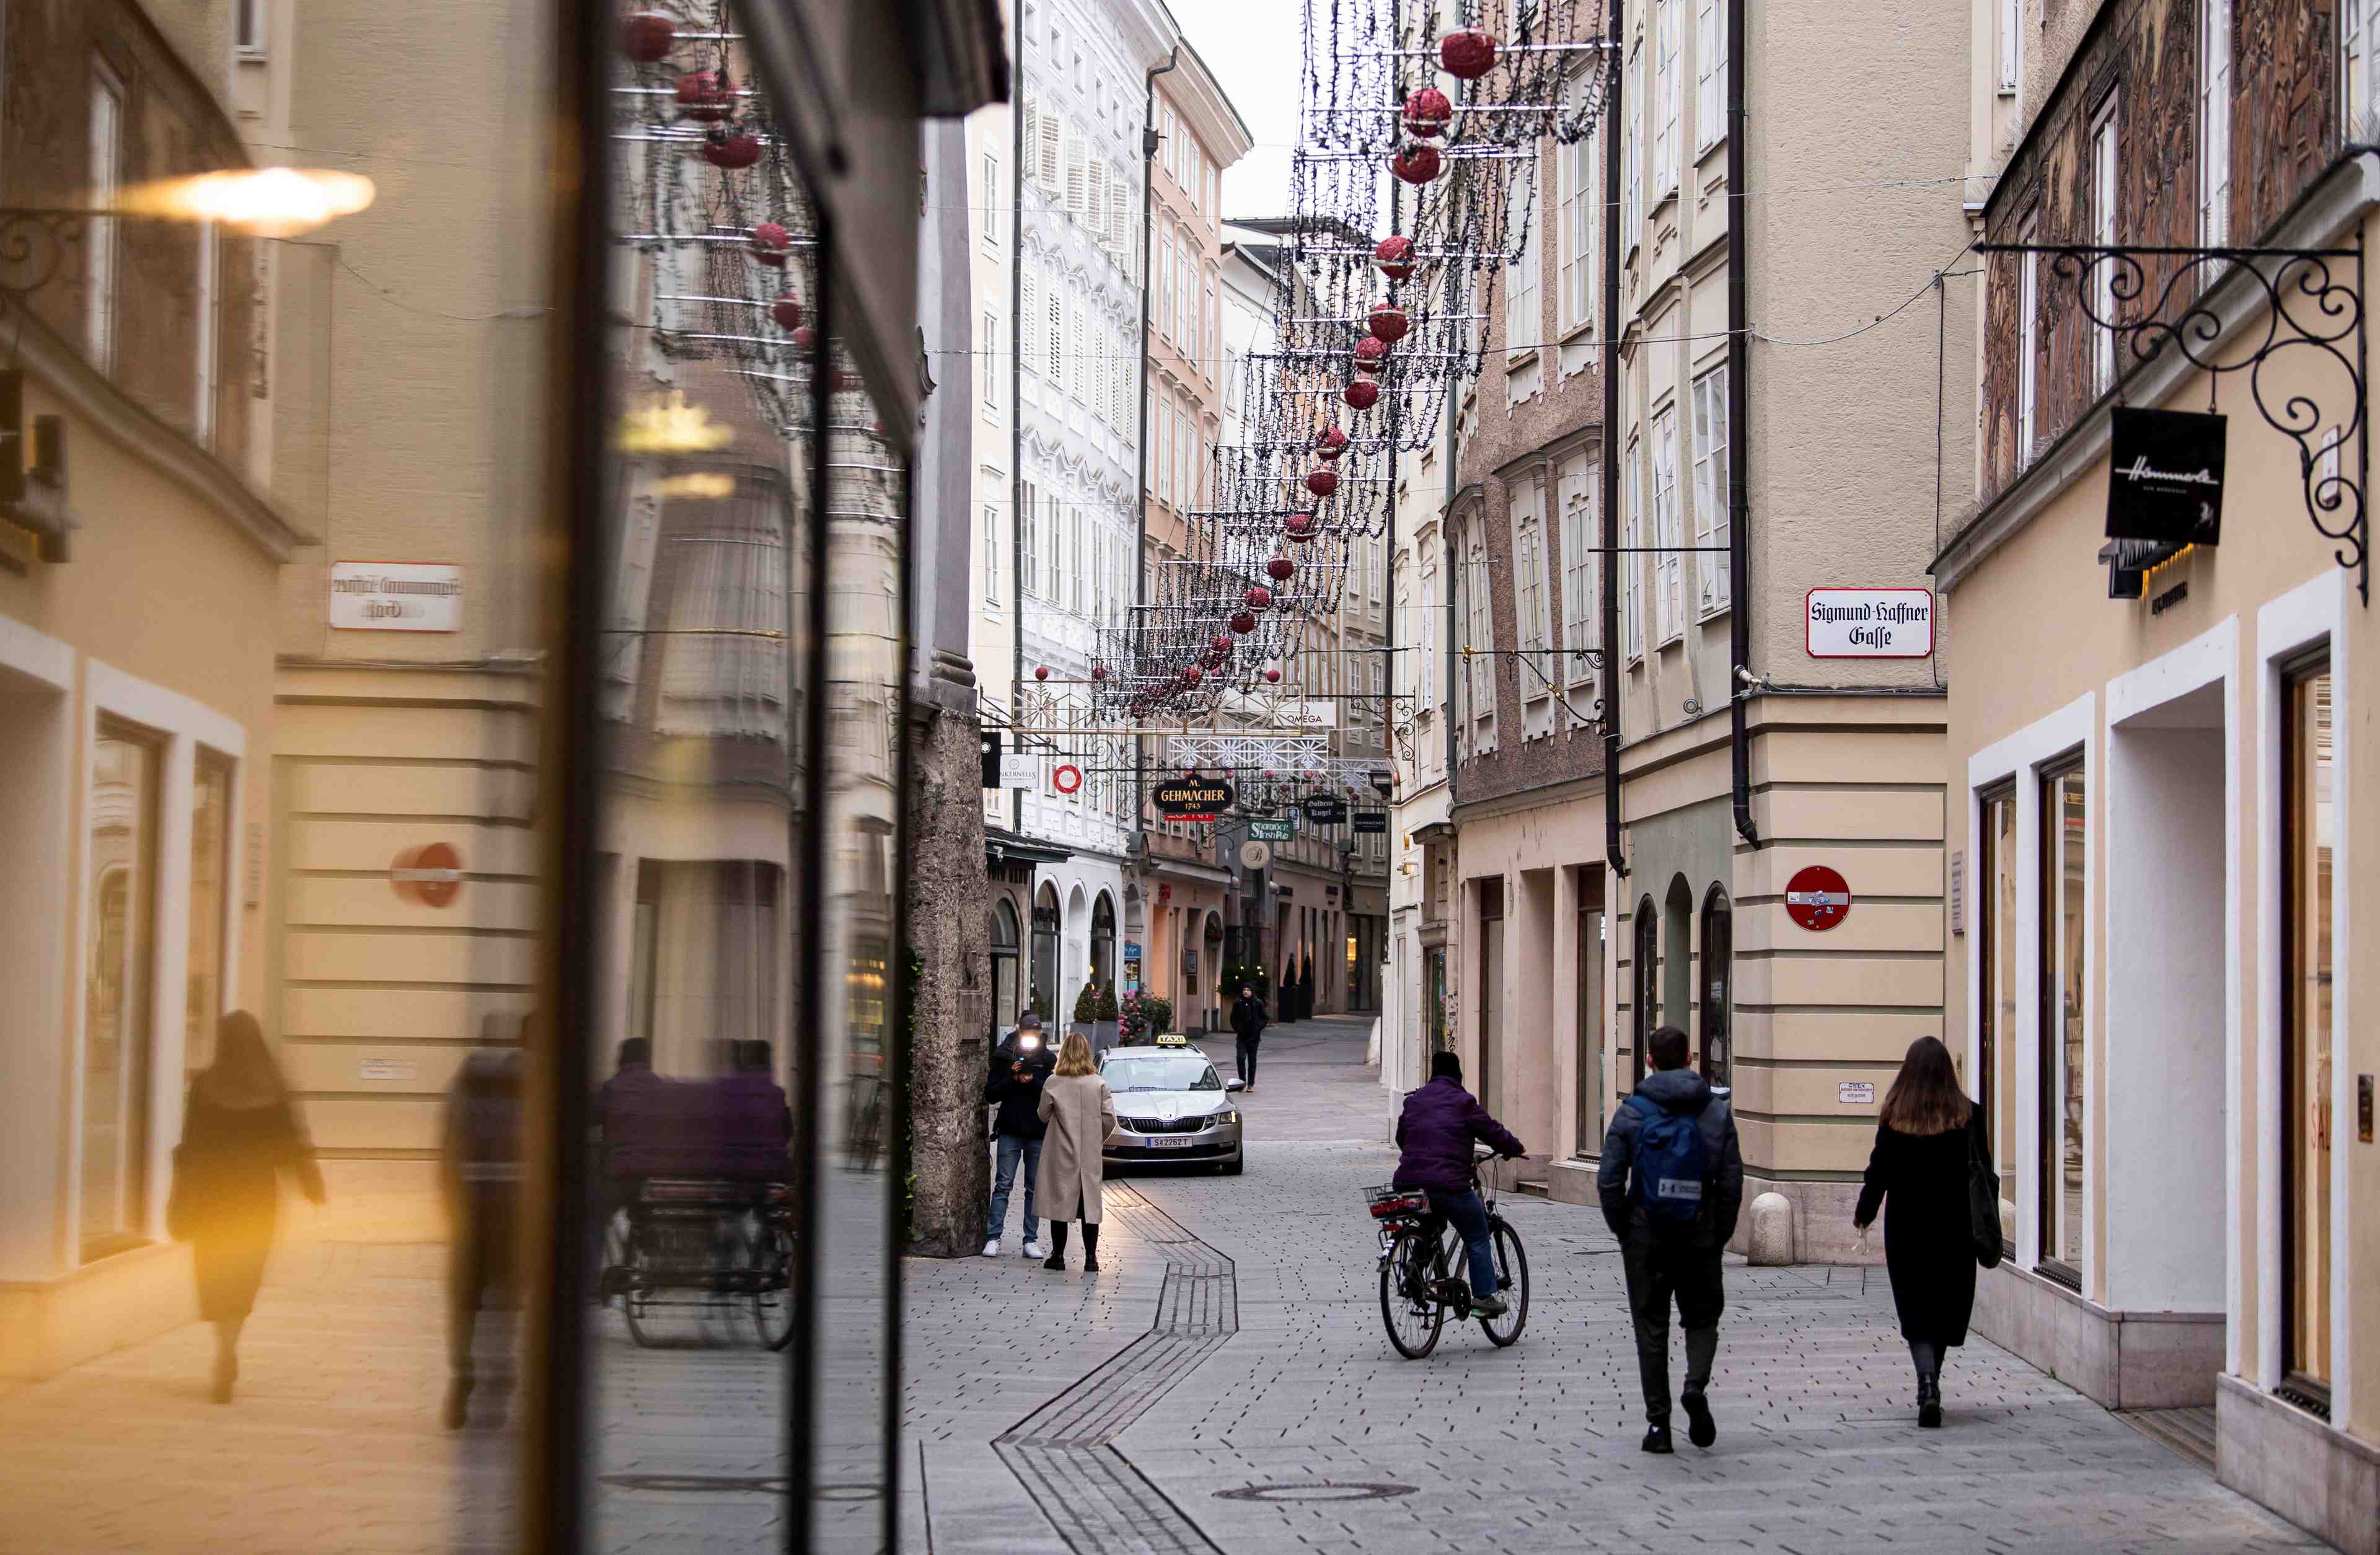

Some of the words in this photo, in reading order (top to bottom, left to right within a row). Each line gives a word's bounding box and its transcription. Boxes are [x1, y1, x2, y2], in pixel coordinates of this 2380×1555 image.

[1287, 715, 1322, 723] OMEGA
[1000, 771, 1036, 779] NKERNELLS
[1161, 790, 1225, 801] GEHMACHER
